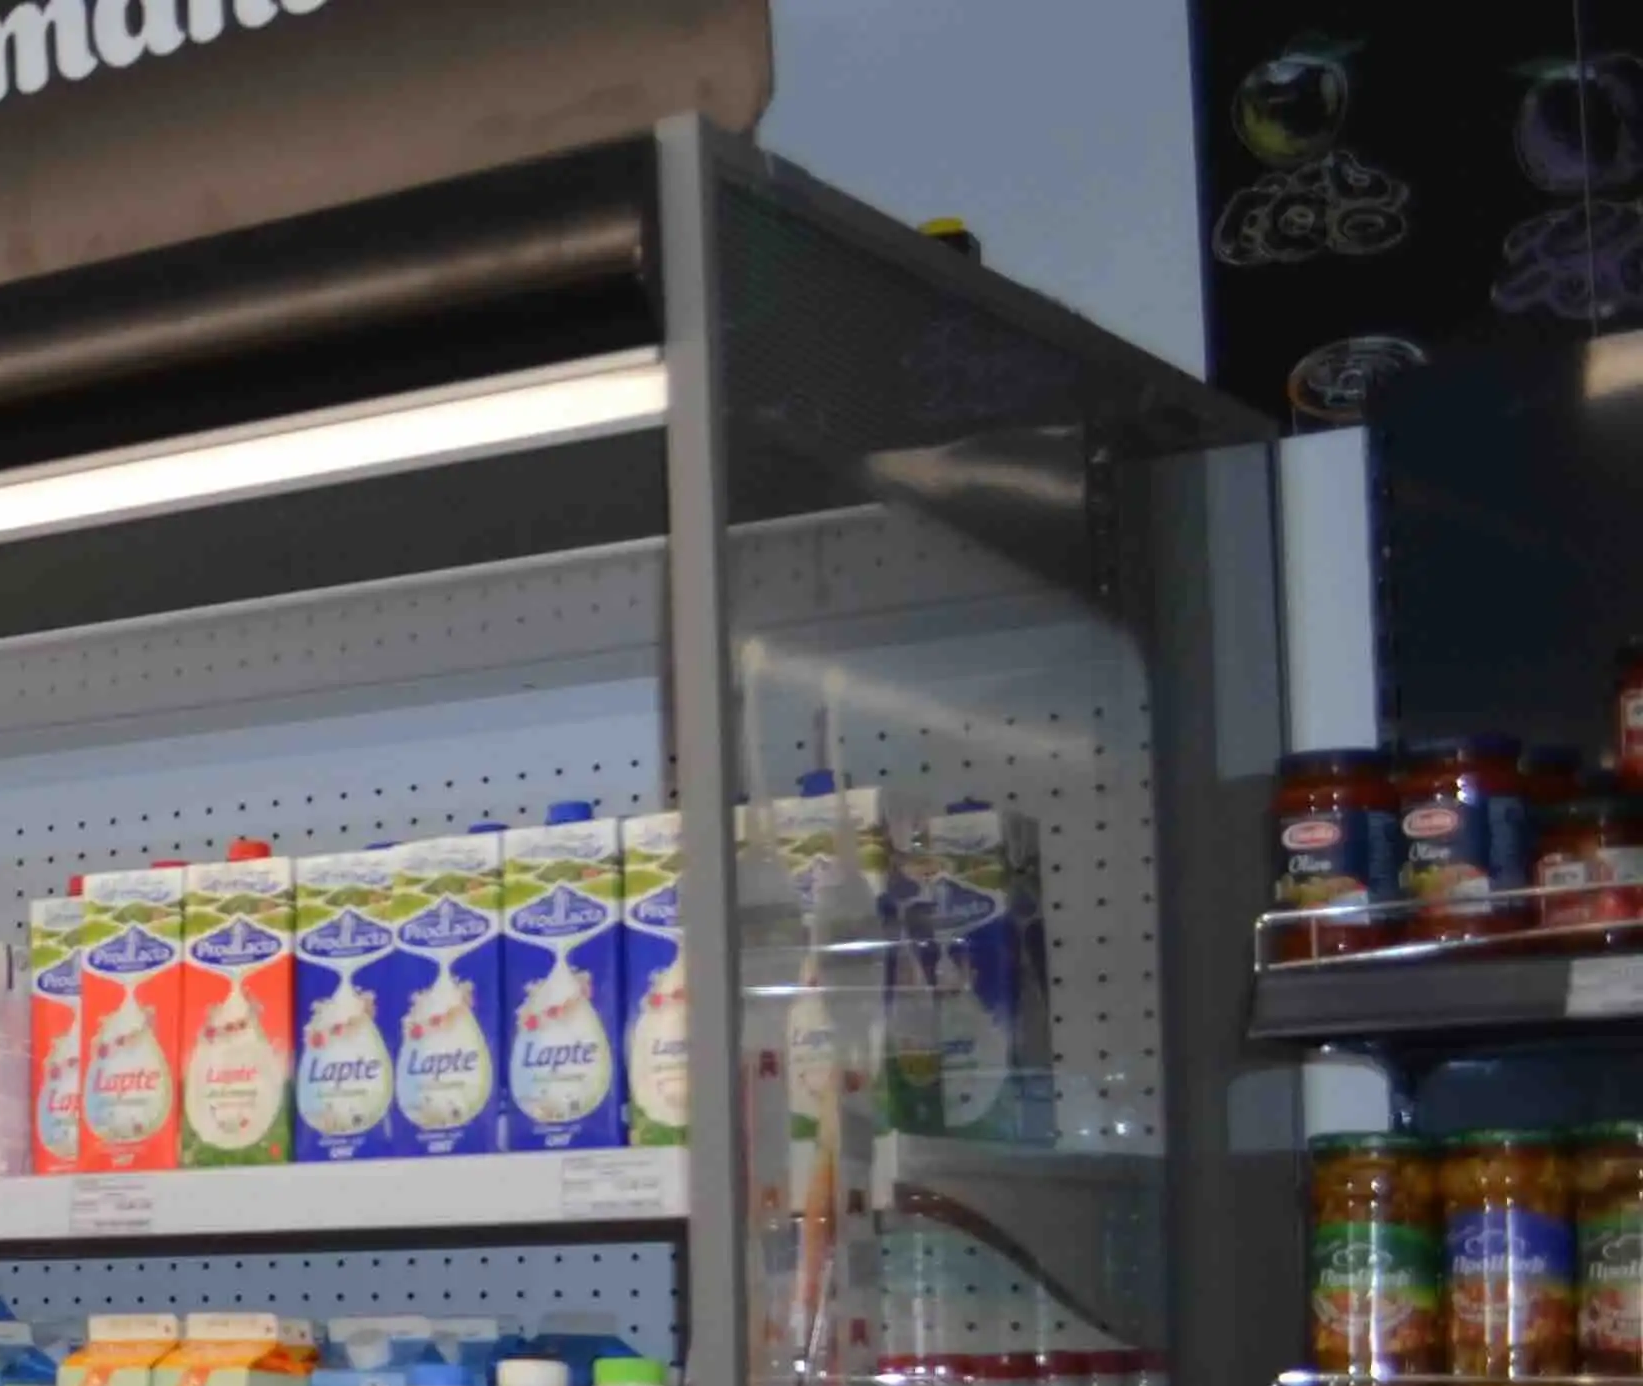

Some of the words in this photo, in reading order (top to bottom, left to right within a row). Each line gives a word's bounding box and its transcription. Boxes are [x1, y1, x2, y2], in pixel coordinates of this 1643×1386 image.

[1288, 853, 1332, 874] Olive
[1407, 841, 1452, 863] Olive
[406, 1047, 479, 1076] Lapte
[521, 1039, 598, 1070] Lapte
[92, 1066, 161, 1094] Lapte
[308, 1056, 382, 1084] Lapte
